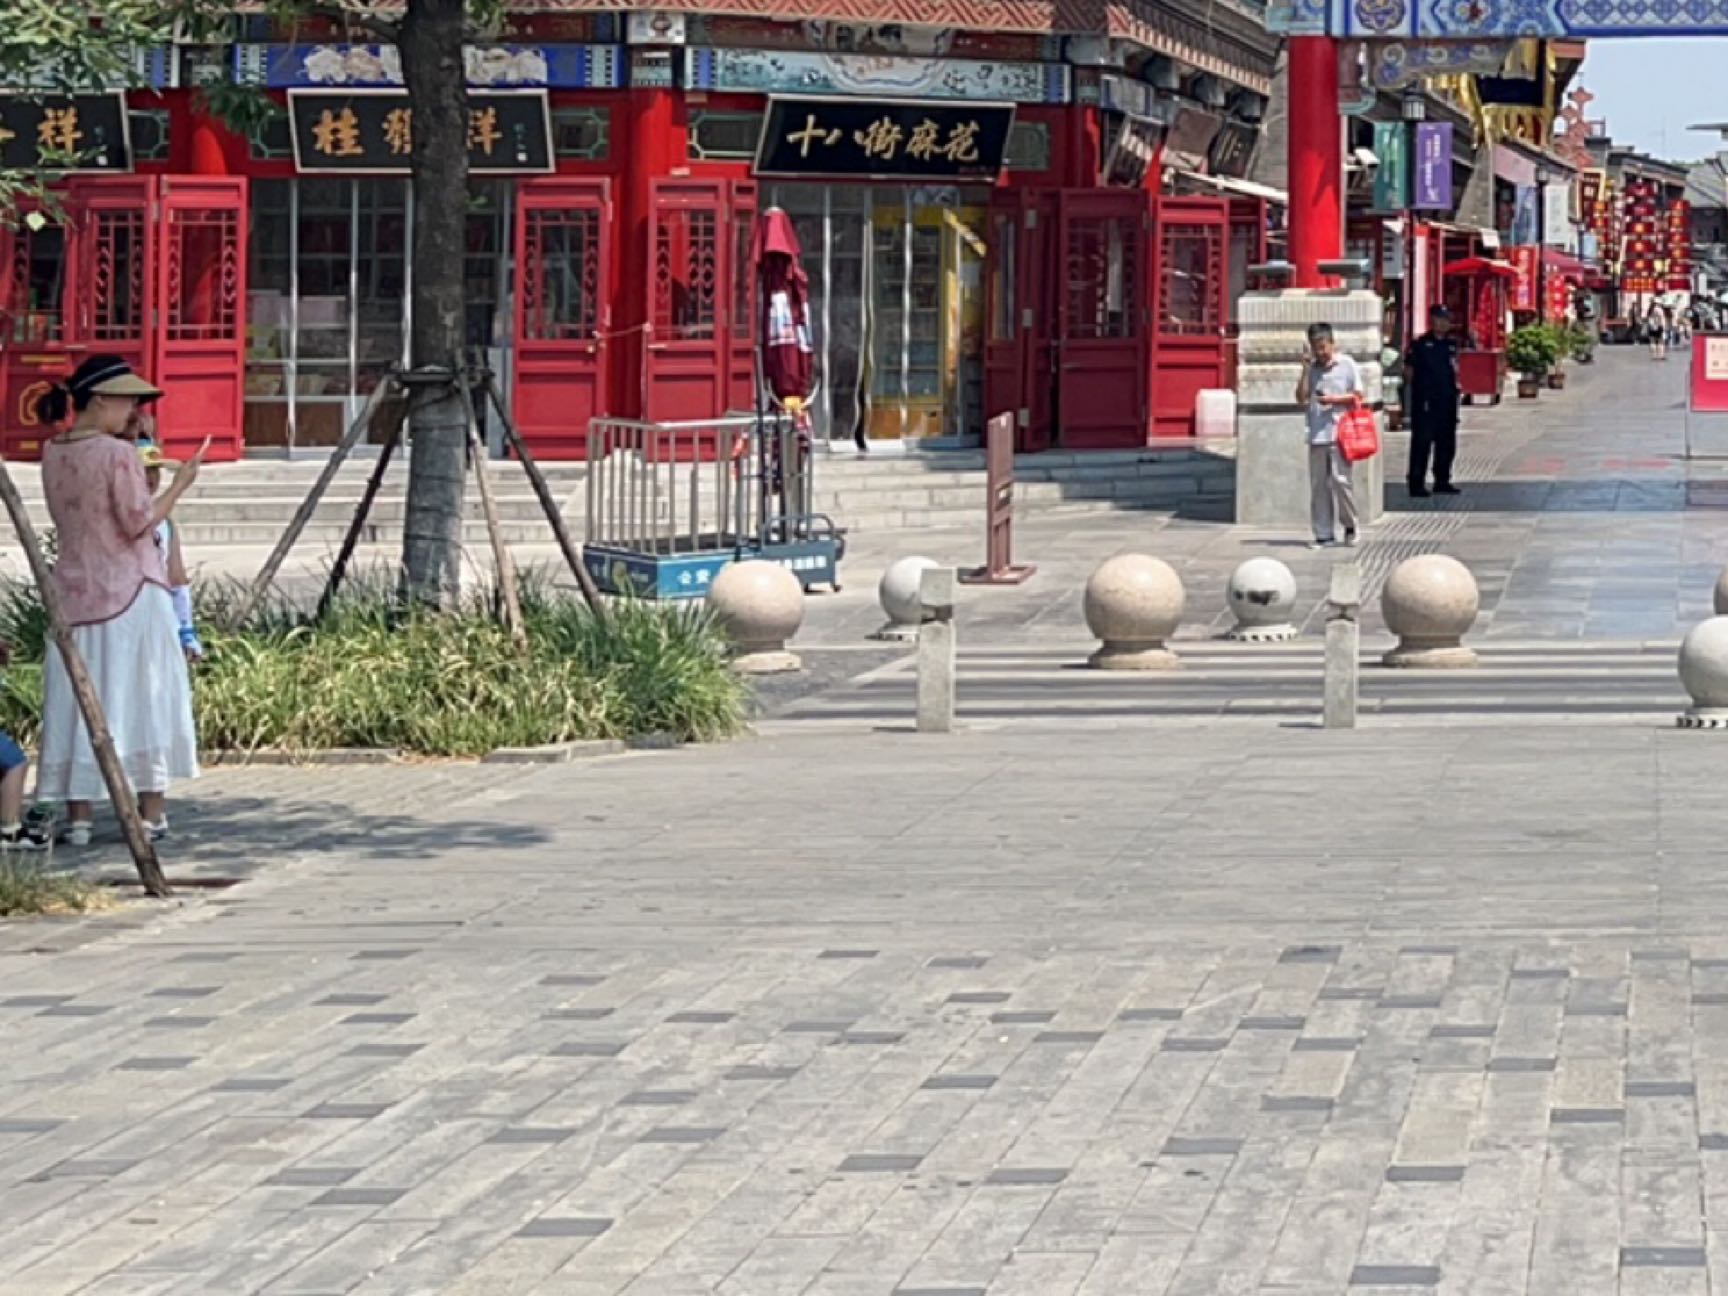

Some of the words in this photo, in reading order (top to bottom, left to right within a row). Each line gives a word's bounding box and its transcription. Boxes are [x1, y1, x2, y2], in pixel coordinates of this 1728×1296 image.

[786, 114, 981, 161] 十八街麻花
